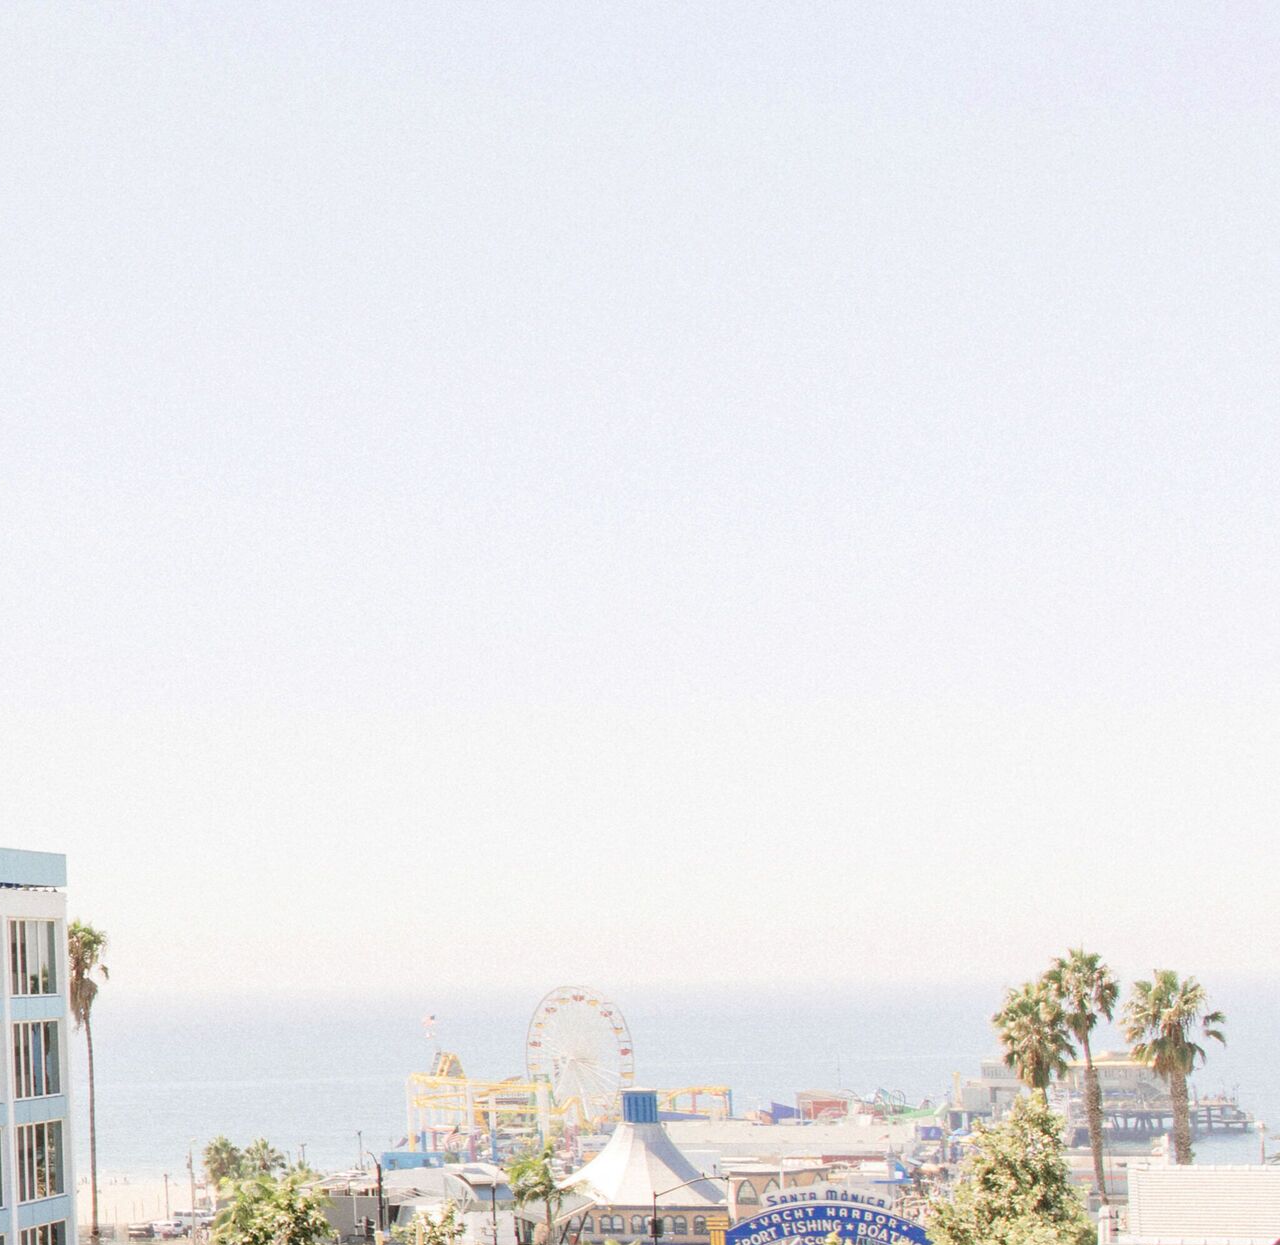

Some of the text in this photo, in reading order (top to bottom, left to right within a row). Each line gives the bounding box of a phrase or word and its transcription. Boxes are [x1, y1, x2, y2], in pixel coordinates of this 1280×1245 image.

[766, 1189, 886, 1208] SANTA MONICA
[759, 1206, 897, 1228] YACHT HARBOR
[782, 1219, 841, 1236] FISHING
